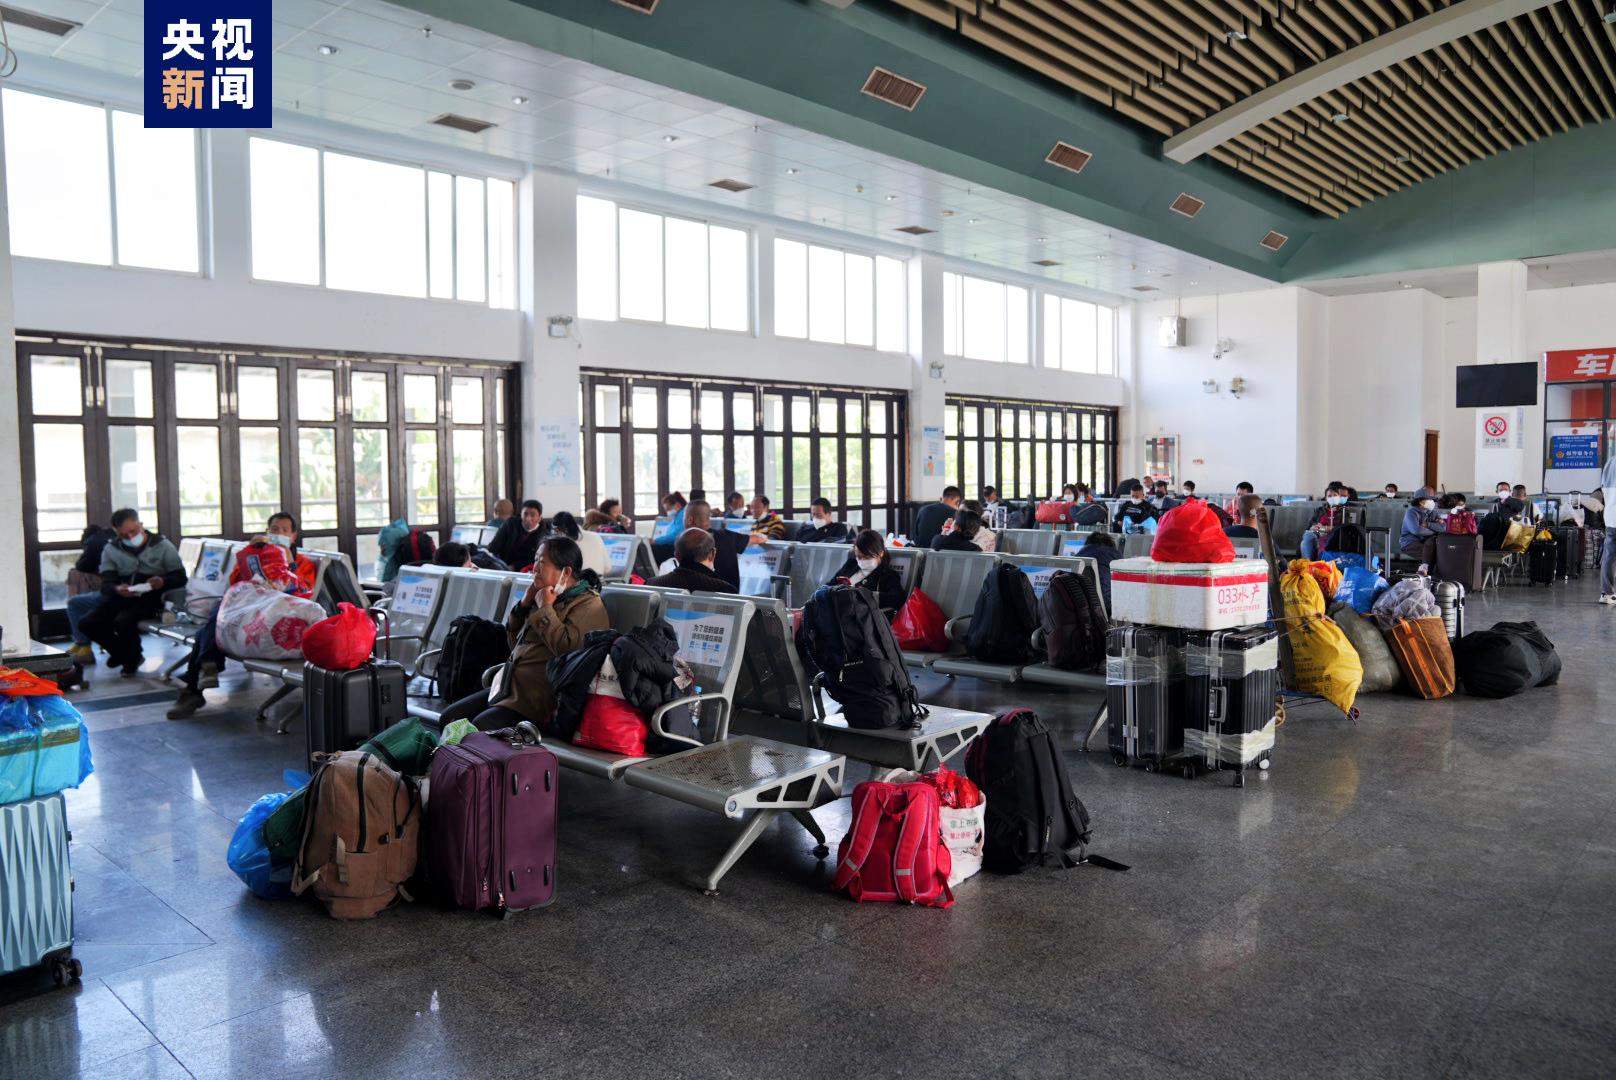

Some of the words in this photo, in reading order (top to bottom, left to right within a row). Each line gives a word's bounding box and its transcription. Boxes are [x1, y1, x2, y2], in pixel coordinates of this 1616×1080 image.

[1573, 353, 1616, 377] 车
[694, 624, 724, 634] 为了您的健康
